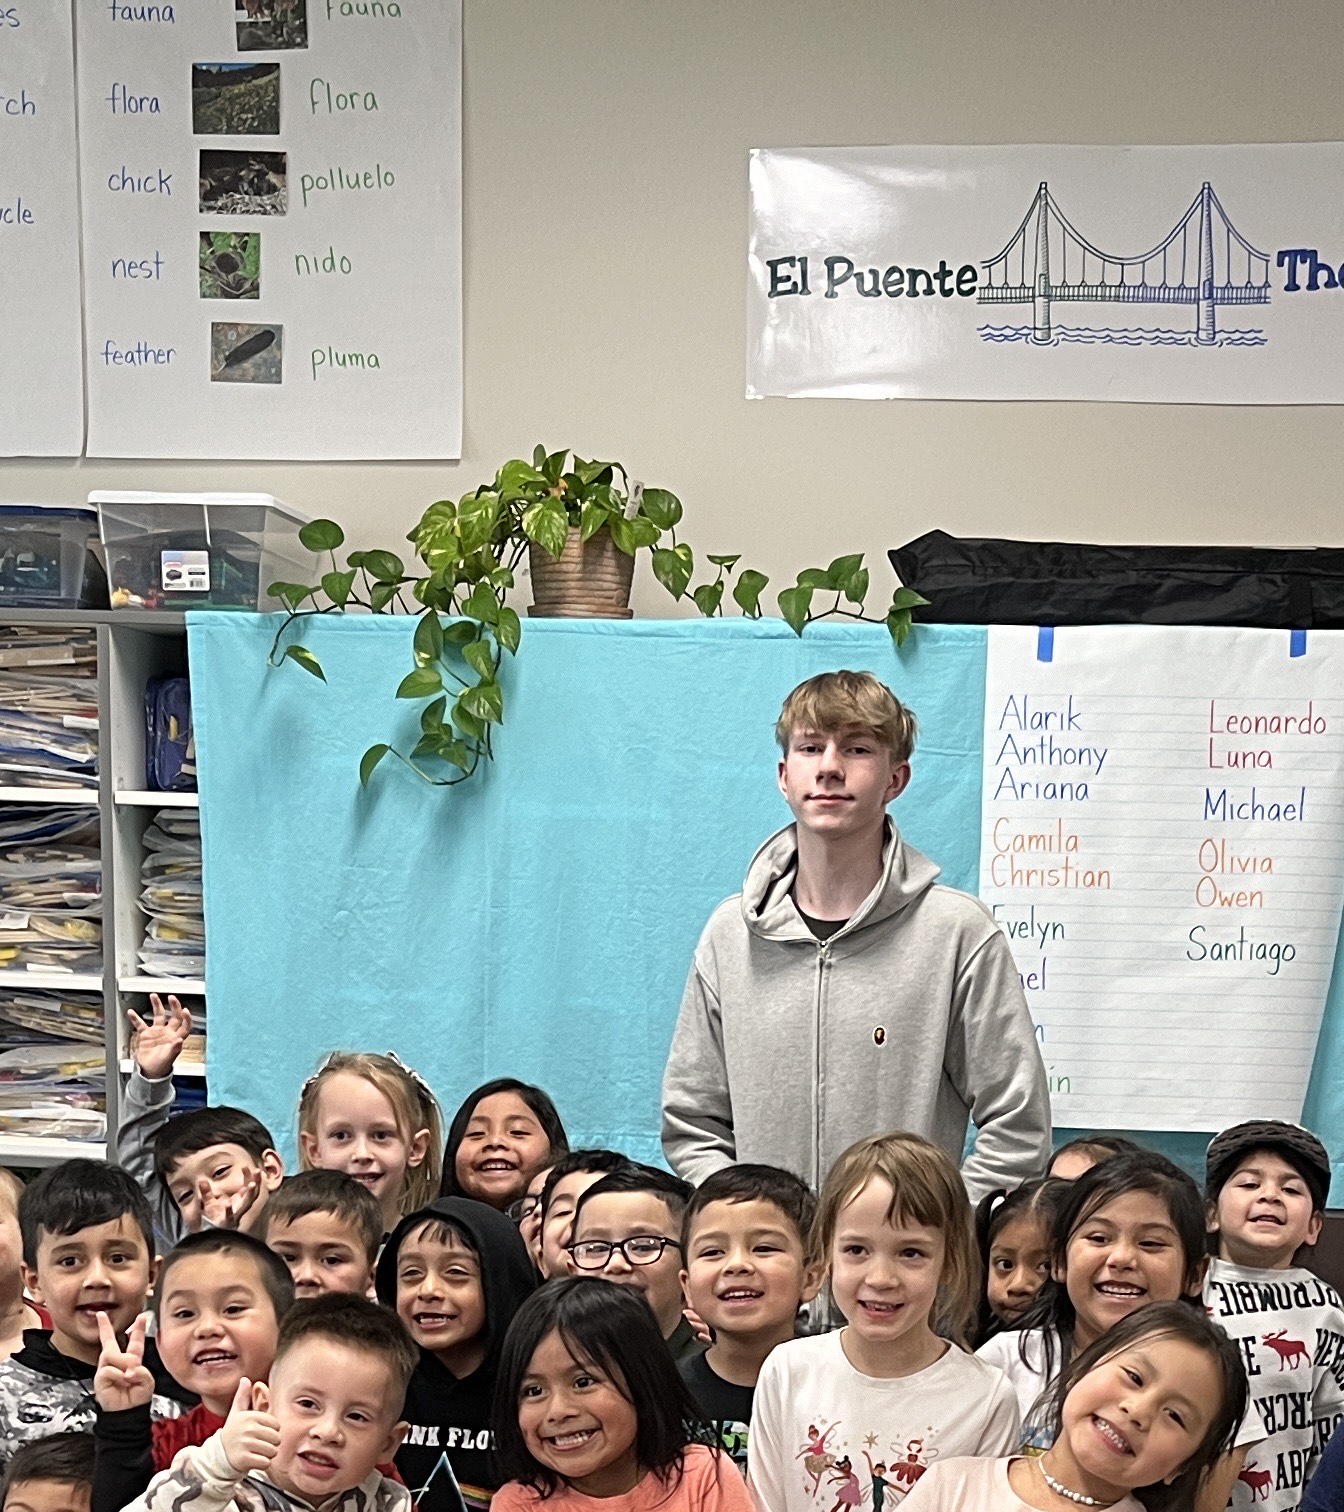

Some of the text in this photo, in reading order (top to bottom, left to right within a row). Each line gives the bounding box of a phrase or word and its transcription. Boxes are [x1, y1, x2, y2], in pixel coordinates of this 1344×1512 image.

[106, 83, 161, 114] flora
[310, 78, 379, 114] flora
[108, 166, 172, 196] chick
[301, 164, 396, 207] polluelo
[112, 250, 165, 279] nest
[295, 246, 352, 275] nido
[767, 256, 978, 300] El Puente
[101, 340, 177, 365] feather
[312, 346, 381, 381] pluma
[999, 694, 1083, 731] Alarik
[1209, 700, 1327, 734] Leonardo
[995, 733, 1108, 775] Anthony
[1208, 737, 1273, 769] Luna
[993, 767, 1089, 801] Ariana
[1203, 786, 1306, 822] Michael
[992, 817, 1079, 853] Camila
[991, 854, 1111, 889] Christian
[1199, 838, 1274, 875] Olivia
[1196, 876, 1264, 909] Owen
[1186, 925, 1296, 975] Santiago
